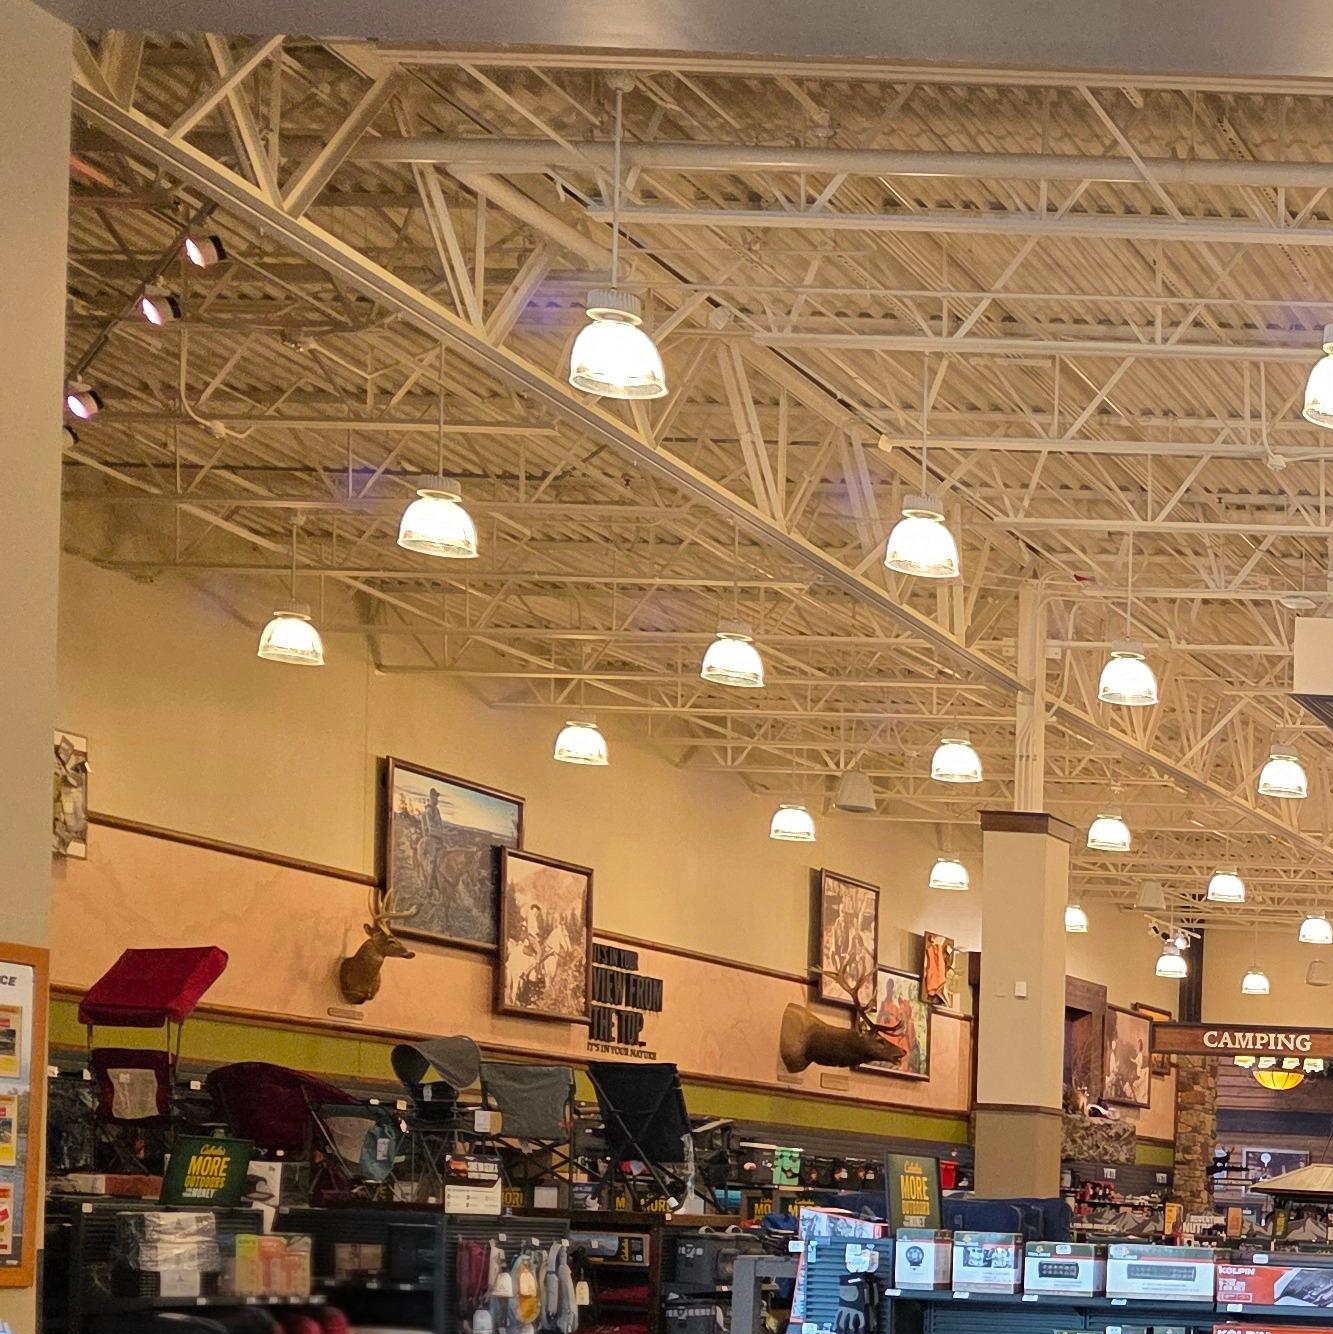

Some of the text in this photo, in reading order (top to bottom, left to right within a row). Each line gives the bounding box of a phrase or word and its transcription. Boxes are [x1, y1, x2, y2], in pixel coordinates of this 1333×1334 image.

[592, 966, 663, 1012] VIEW FROM
[589, 1005, 615, 1042] THE
[1203, 1031, 1312, 1052] CAMPING
[630, 1048, 657, 1060] NATURE
[187, 1156, 231, 1177] MORE
[900, 1174, 930, 1201] MORE
[1218, 1266, 1256, 1276] KOLPIN
